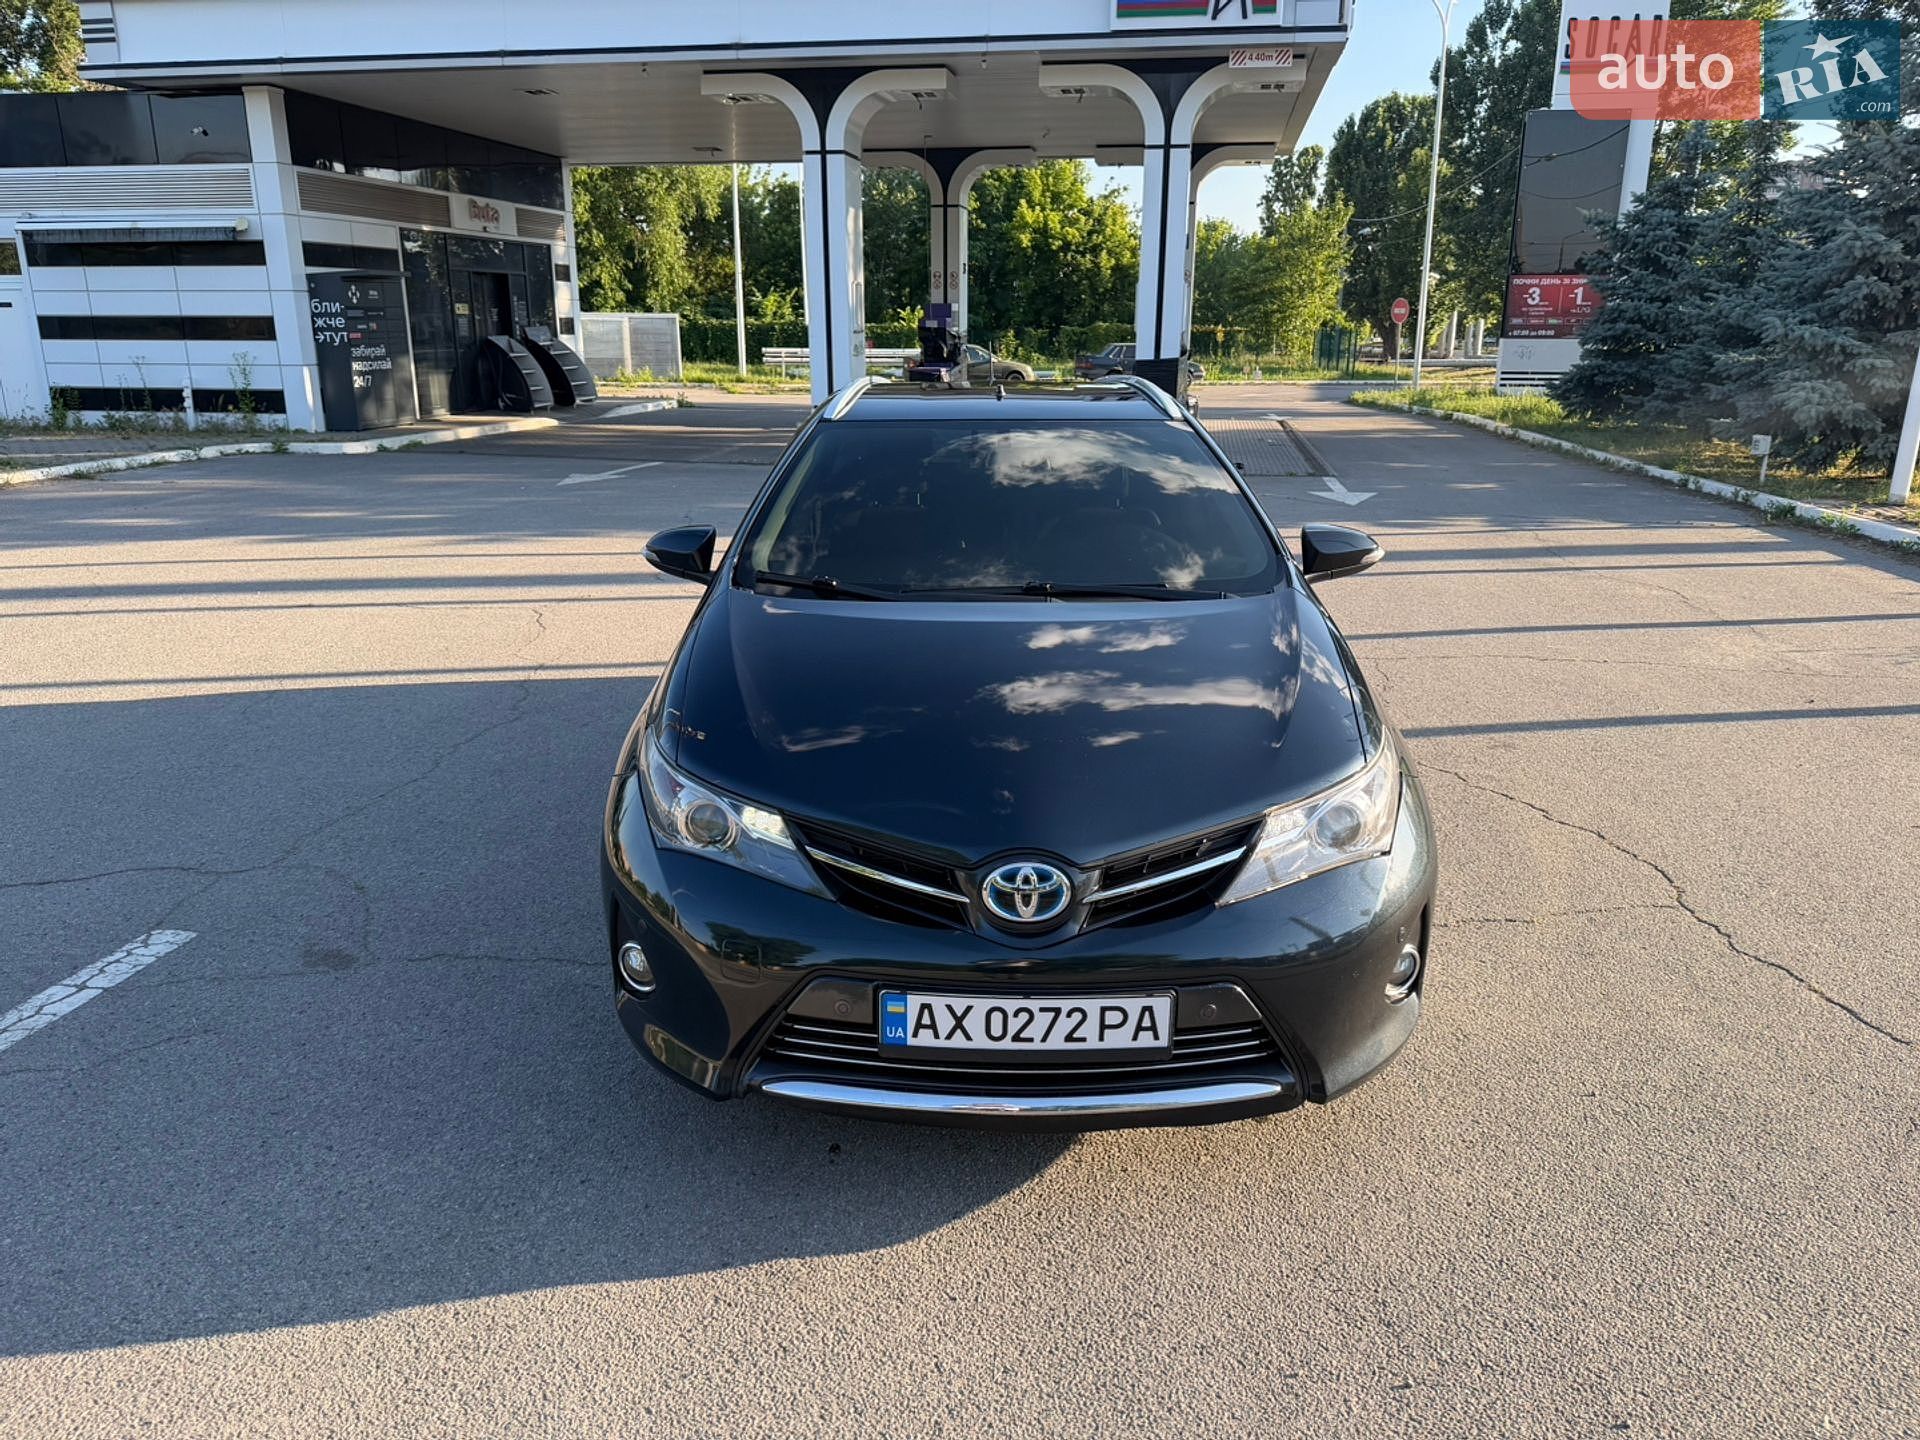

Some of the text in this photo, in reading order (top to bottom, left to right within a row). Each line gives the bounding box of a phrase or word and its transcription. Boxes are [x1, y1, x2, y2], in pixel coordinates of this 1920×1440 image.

[1564, 13, 1665, 58] SOCAR
[1523, 287, 1540, 305] -3
[1569, 287, 1584, 305] -1
[311, 299, 345, 313] бли-
[314, 317, 345, 328] жче
[351, 344, 386, 358] забирай
[352, 357, 392, 371] надсилай
[353, 375, 372, 388] 24/7
[911, 1002, 1160, 1043] AX 0272 PA
[886, 1026, 905, 1039] UA
